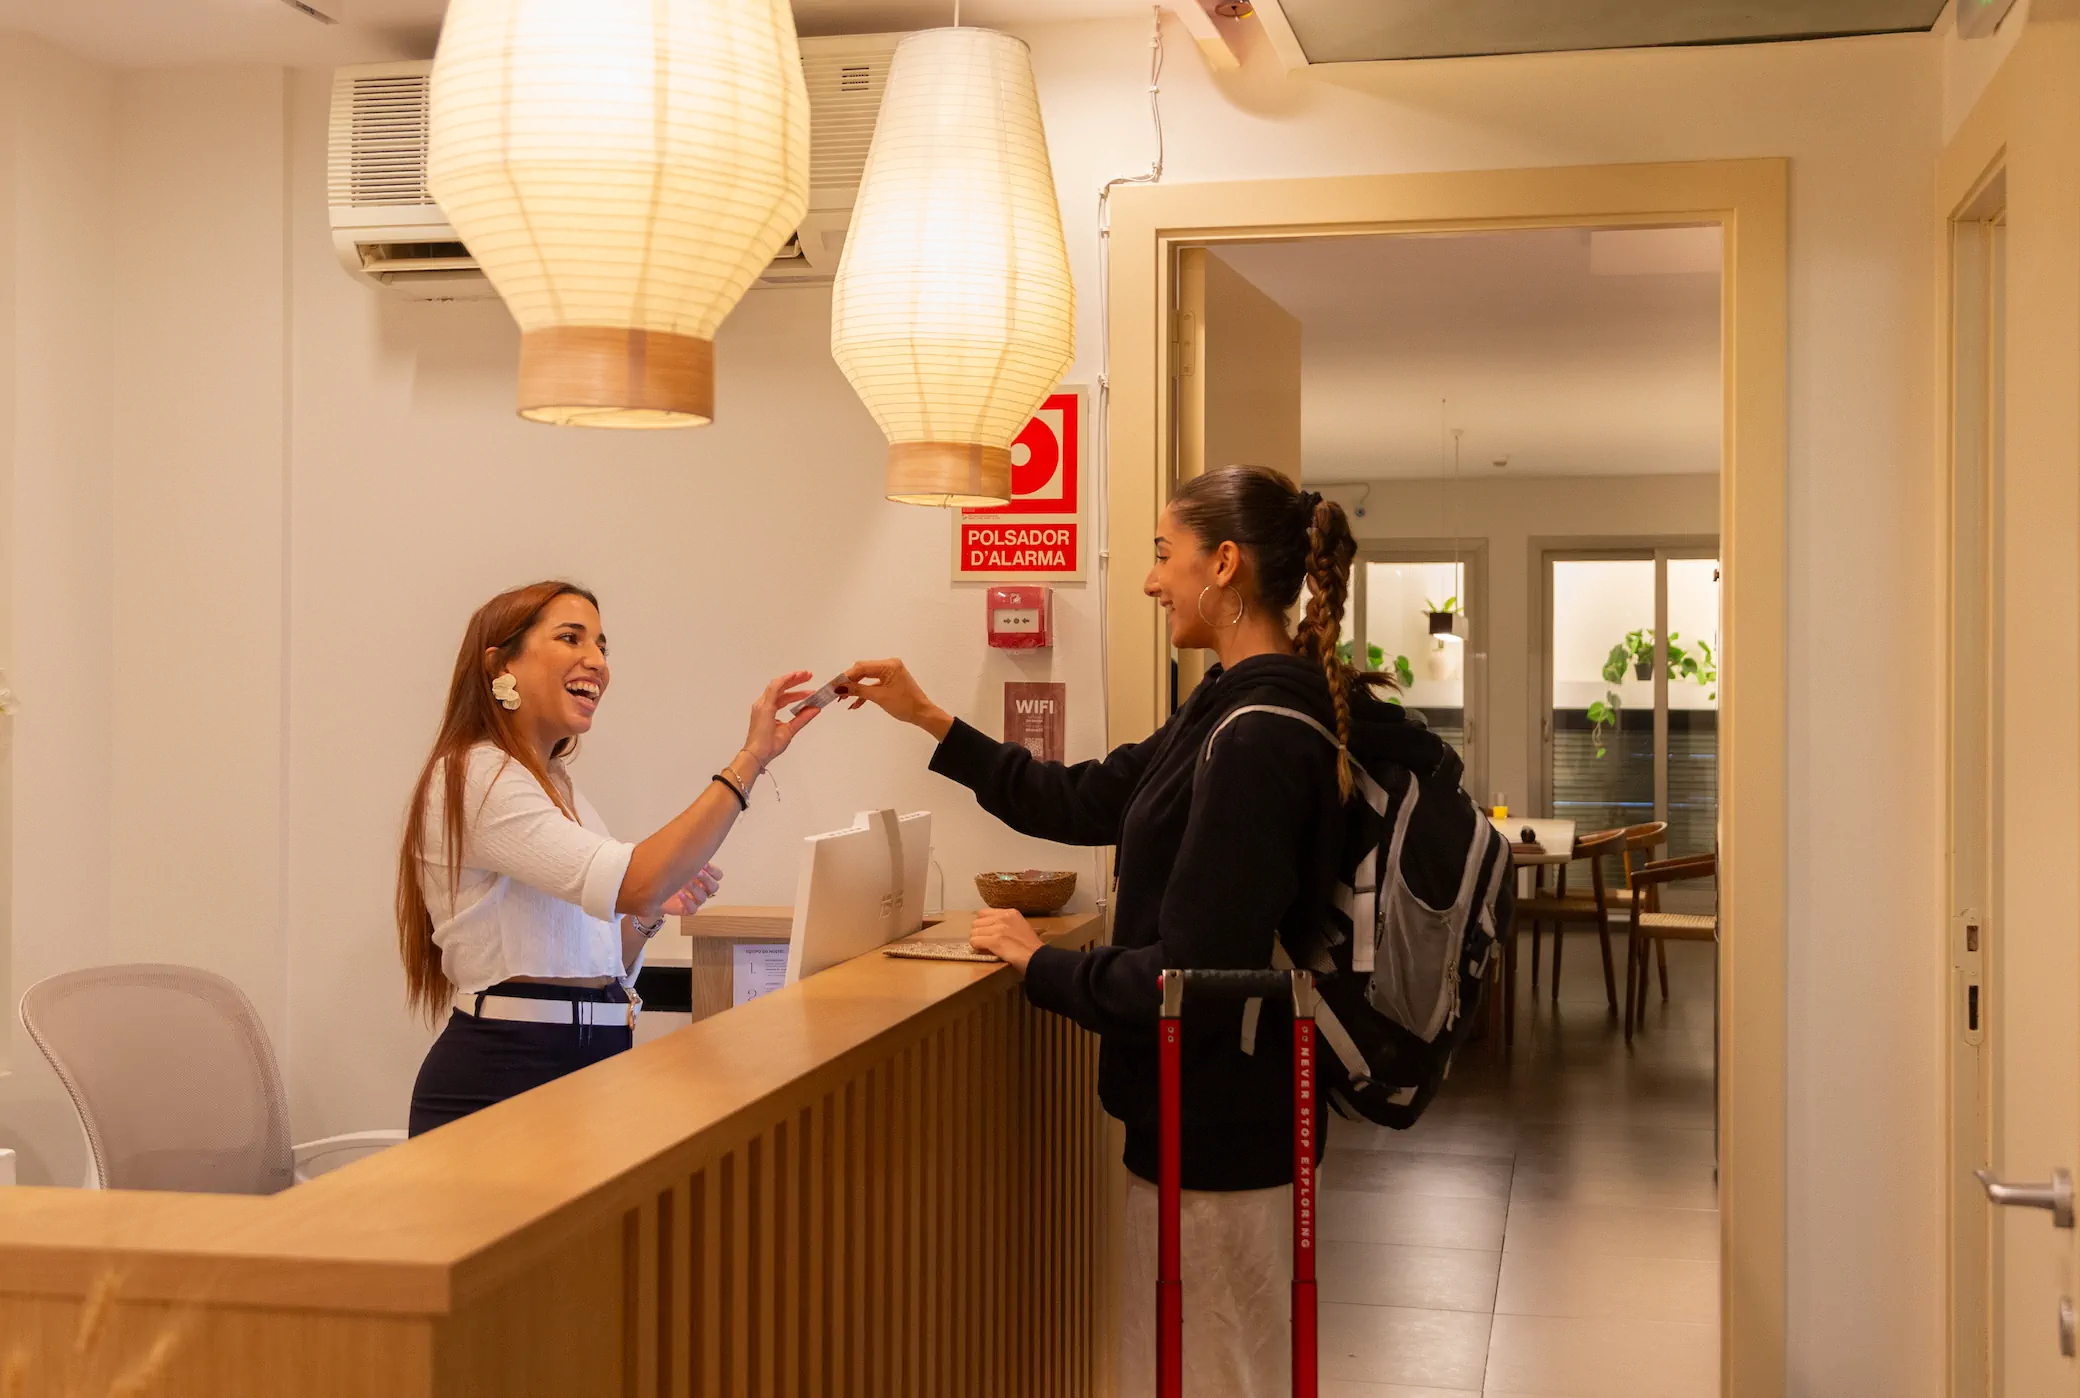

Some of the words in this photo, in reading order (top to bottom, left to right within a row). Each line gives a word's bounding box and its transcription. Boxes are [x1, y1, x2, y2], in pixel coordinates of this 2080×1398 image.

[968, 529, 1070, 546] POLSADOR
[1015, 699, 1054, 714] WIFI
[1300, 1047, 1310, 1100] NEVER
[1300, 1107, 1310, 1148] STOP
[1300, 1156, 1310, 1248] EXPLORING
